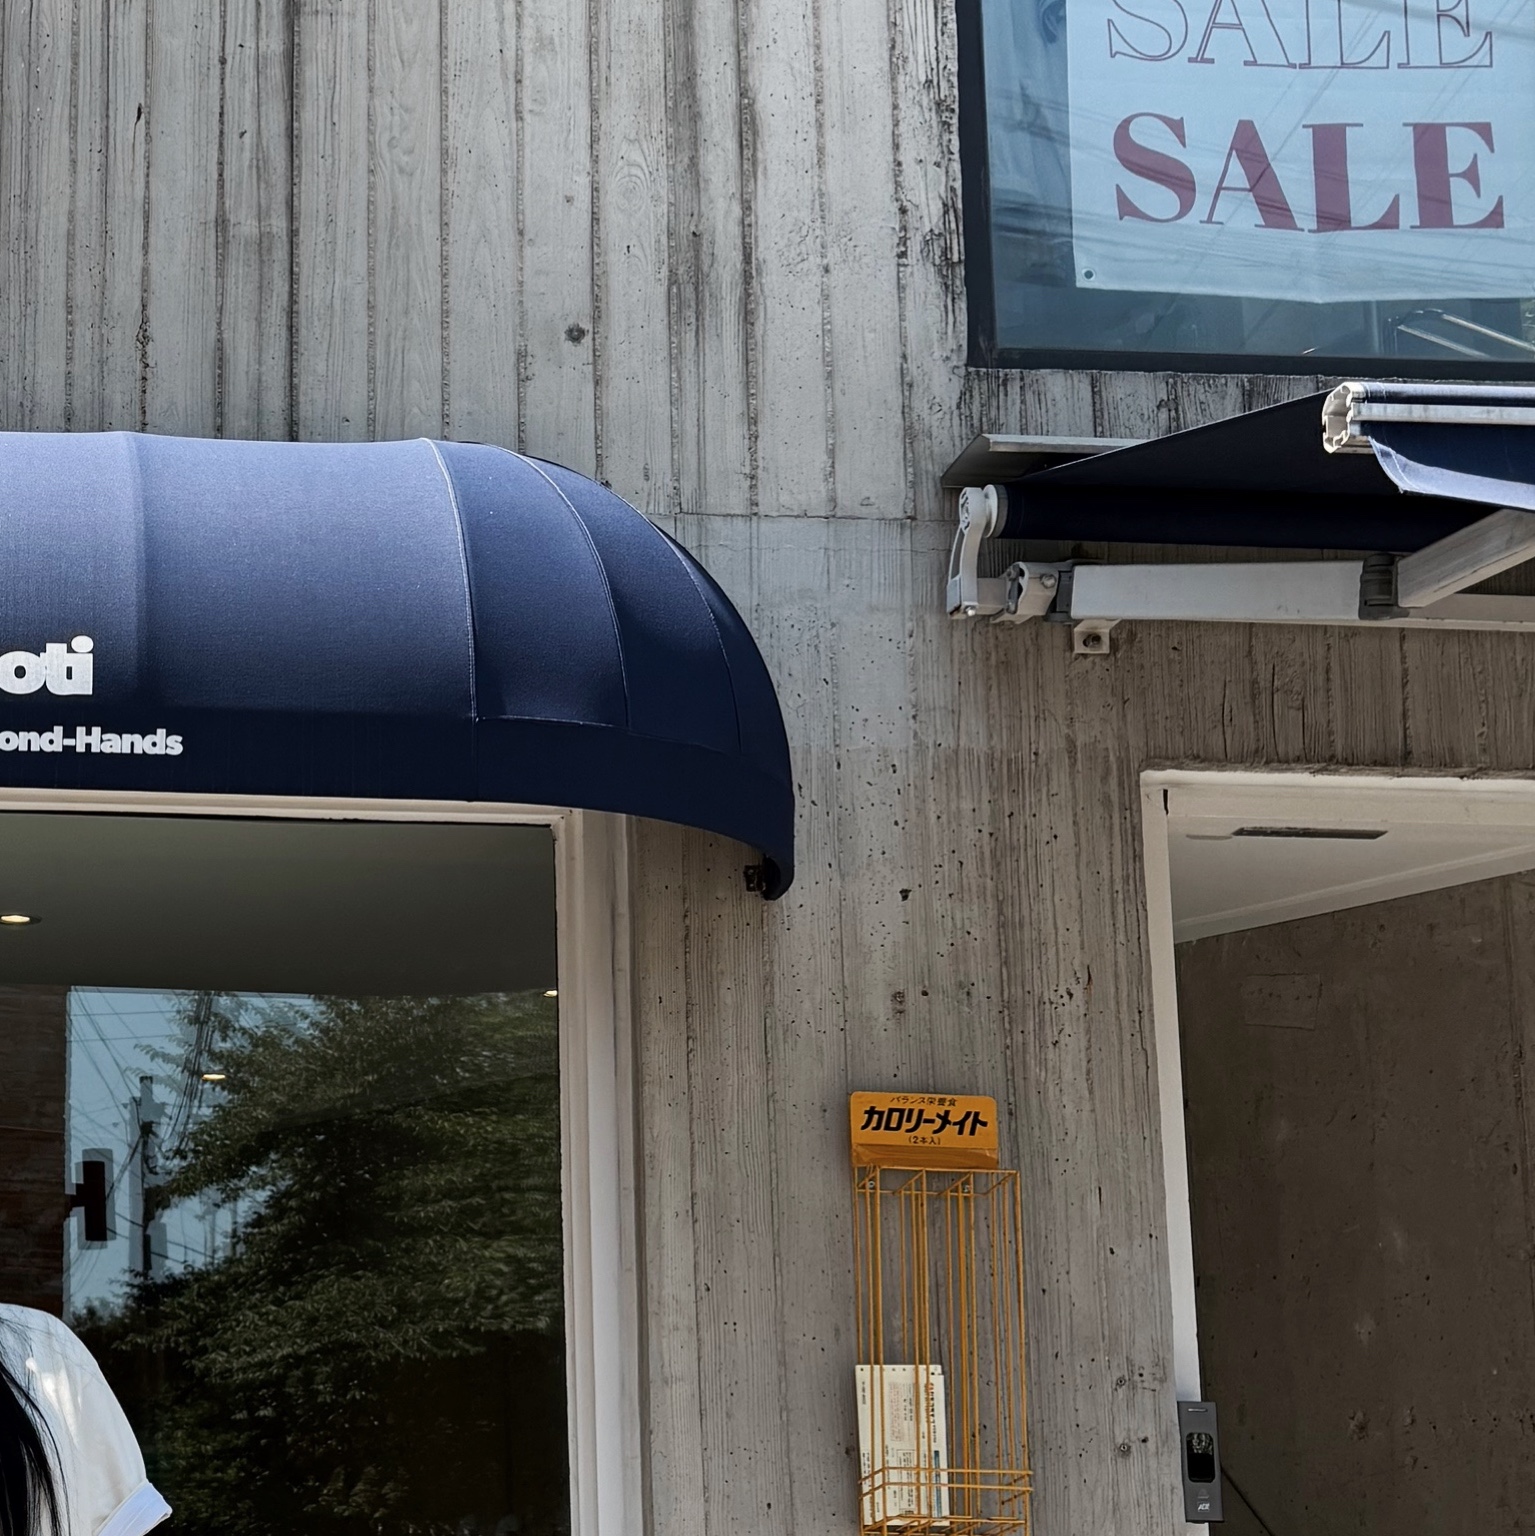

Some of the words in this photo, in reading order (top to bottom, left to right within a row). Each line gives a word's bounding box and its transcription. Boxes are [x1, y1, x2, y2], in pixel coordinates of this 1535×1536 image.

[1107, 0, 1495, 70] SALE
[1112, 111, 1505, 235] SALE
[860, 1106, 988, 1136] カロリーメイト
